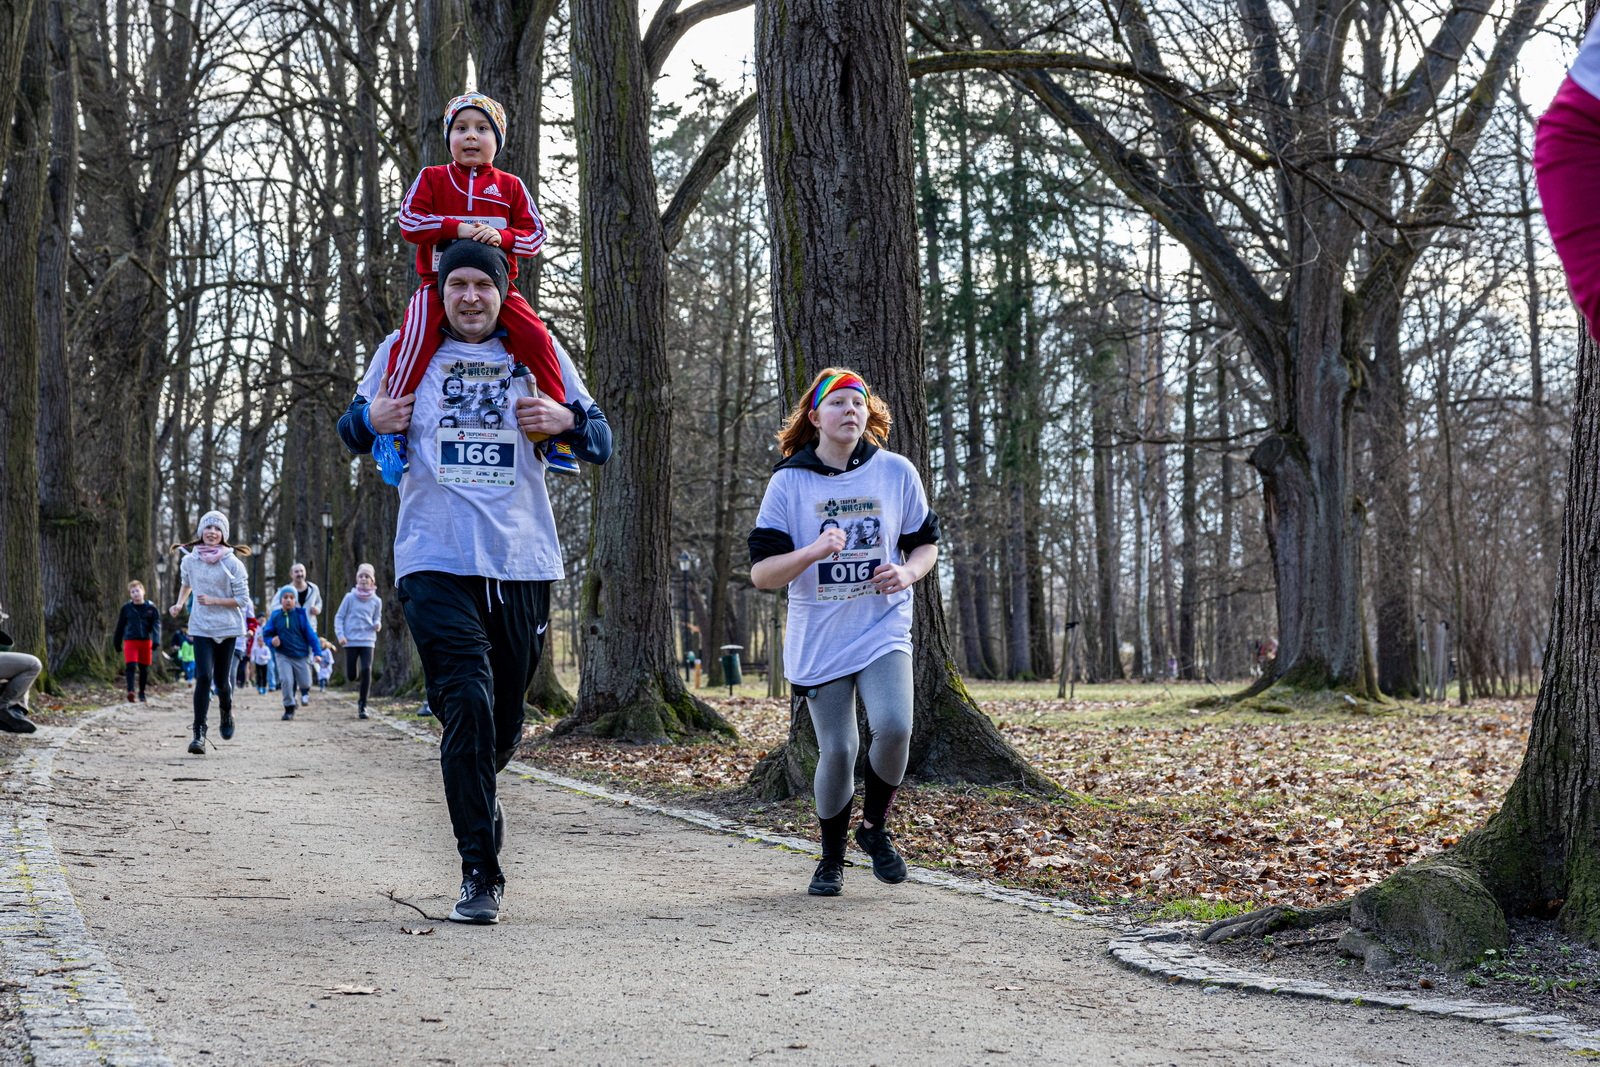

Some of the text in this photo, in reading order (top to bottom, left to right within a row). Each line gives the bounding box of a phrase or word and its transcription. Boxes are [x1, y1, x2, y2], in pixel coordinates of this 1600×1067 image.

[467, 367, 500, 376] WILCZYM
[454, 443, 500, 465] 166
[841, 503, 873, 512] WILCZYM
[831, 562, 870, 582] 016
